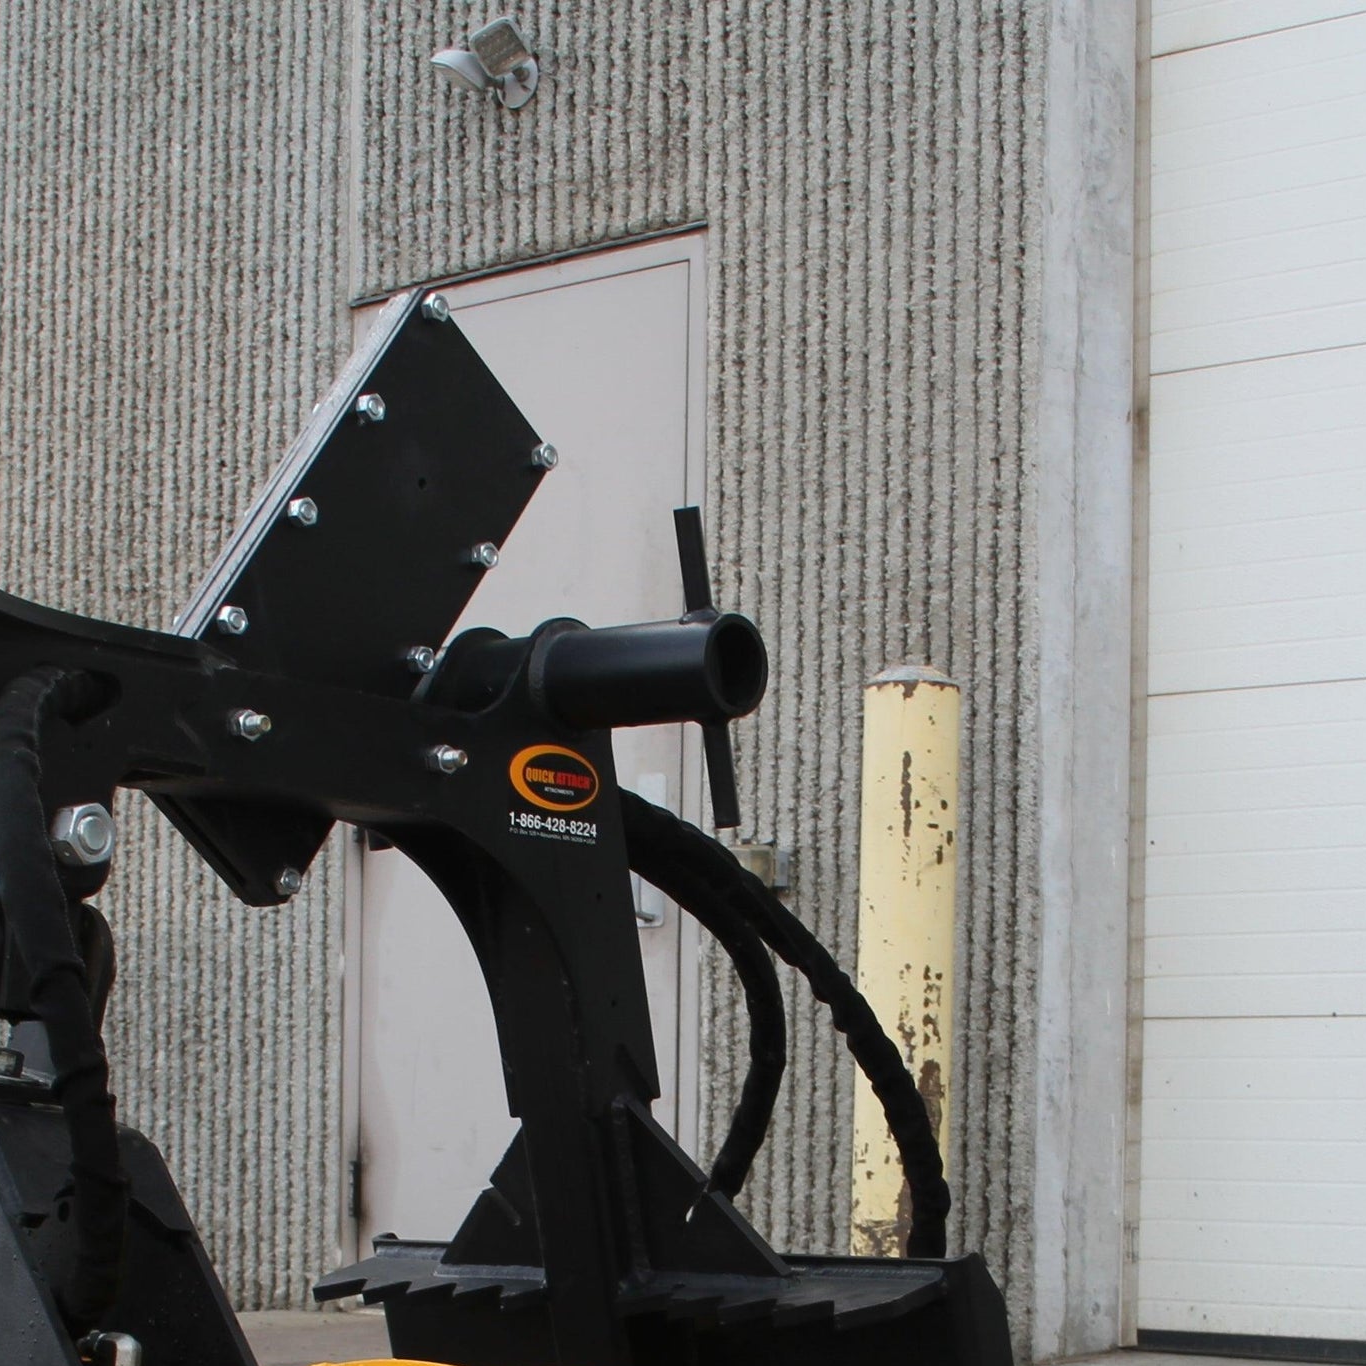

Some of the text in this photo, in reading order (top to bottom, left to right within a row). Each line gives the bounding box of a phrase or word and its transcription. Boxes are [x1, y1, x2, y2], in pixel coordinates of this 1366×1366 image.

[525, 767, 590, 789] QUICK ATTACH
[509, 811, 597, 837] 1-866-428-8224
